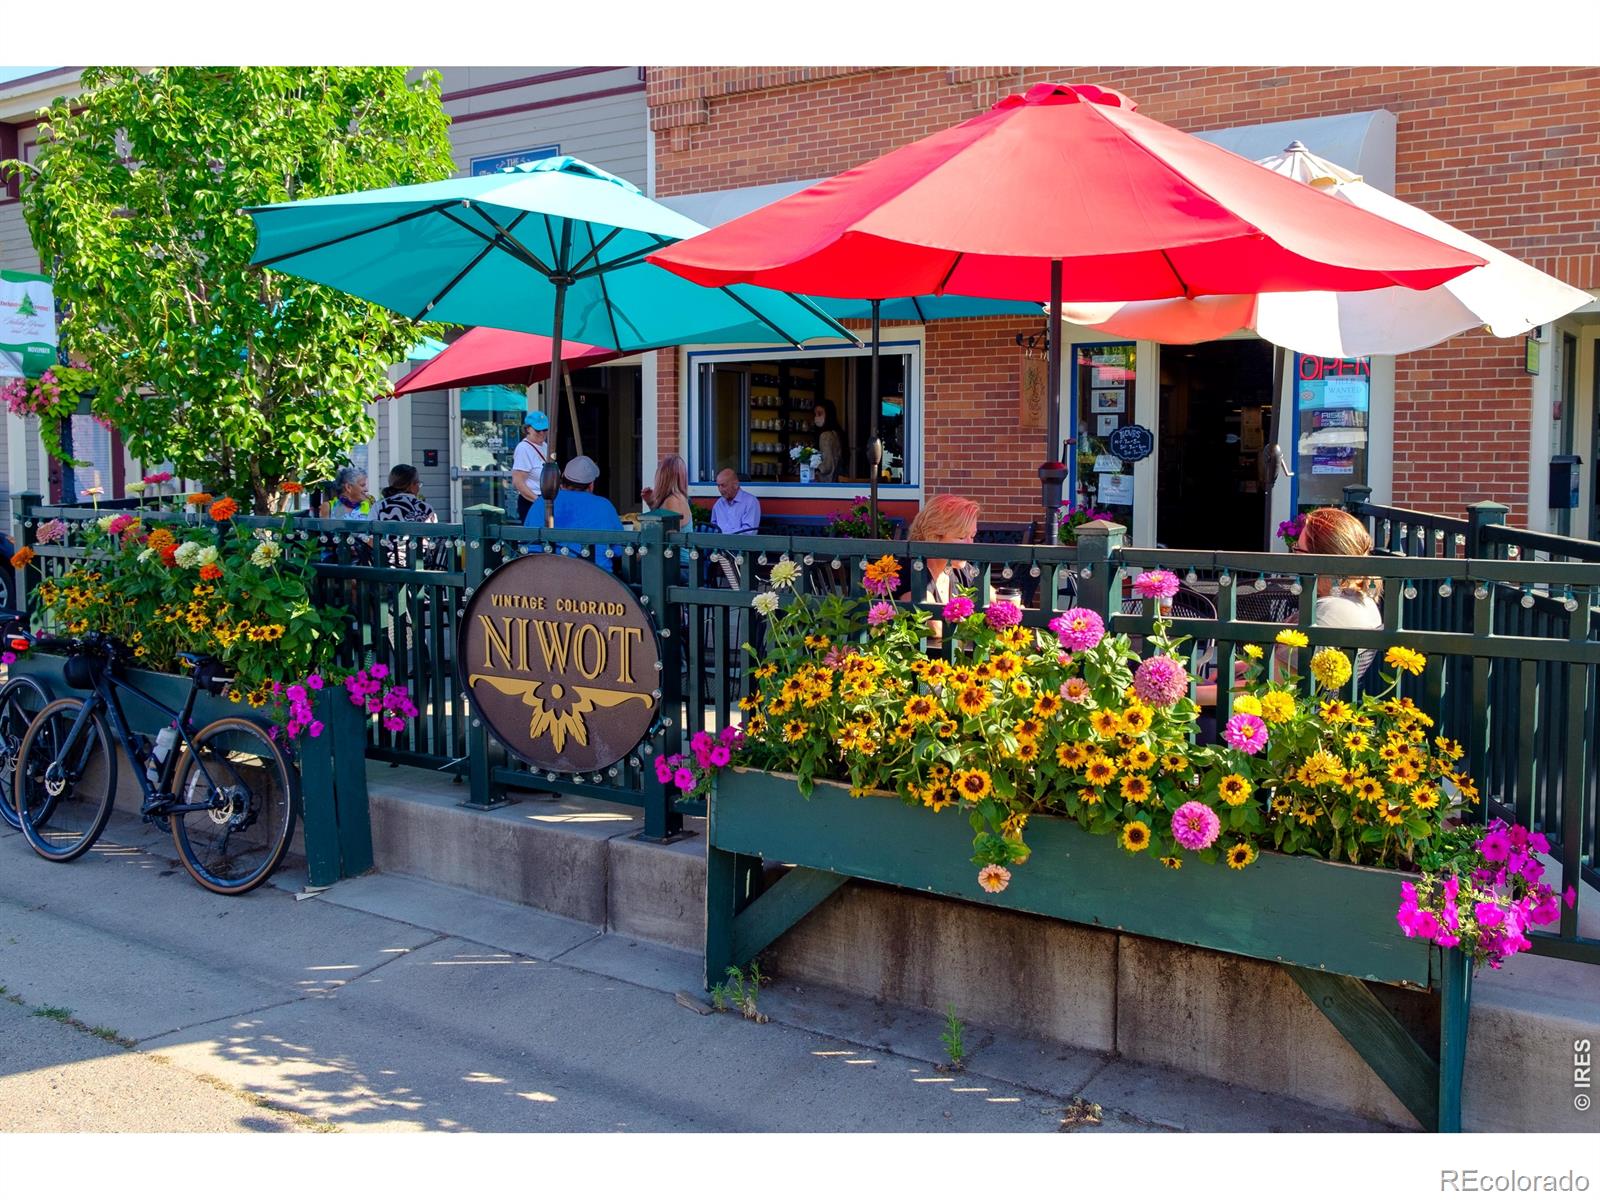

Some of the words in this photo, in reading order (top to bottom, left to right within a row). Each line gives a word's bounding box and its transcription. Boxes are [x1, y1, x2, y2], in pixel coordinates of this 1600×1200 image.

[491, 594, 546, 610] VINTAGE
[556, 598, 626, 617] COLORADO
[478, 615, 643, 684] NIWOT
